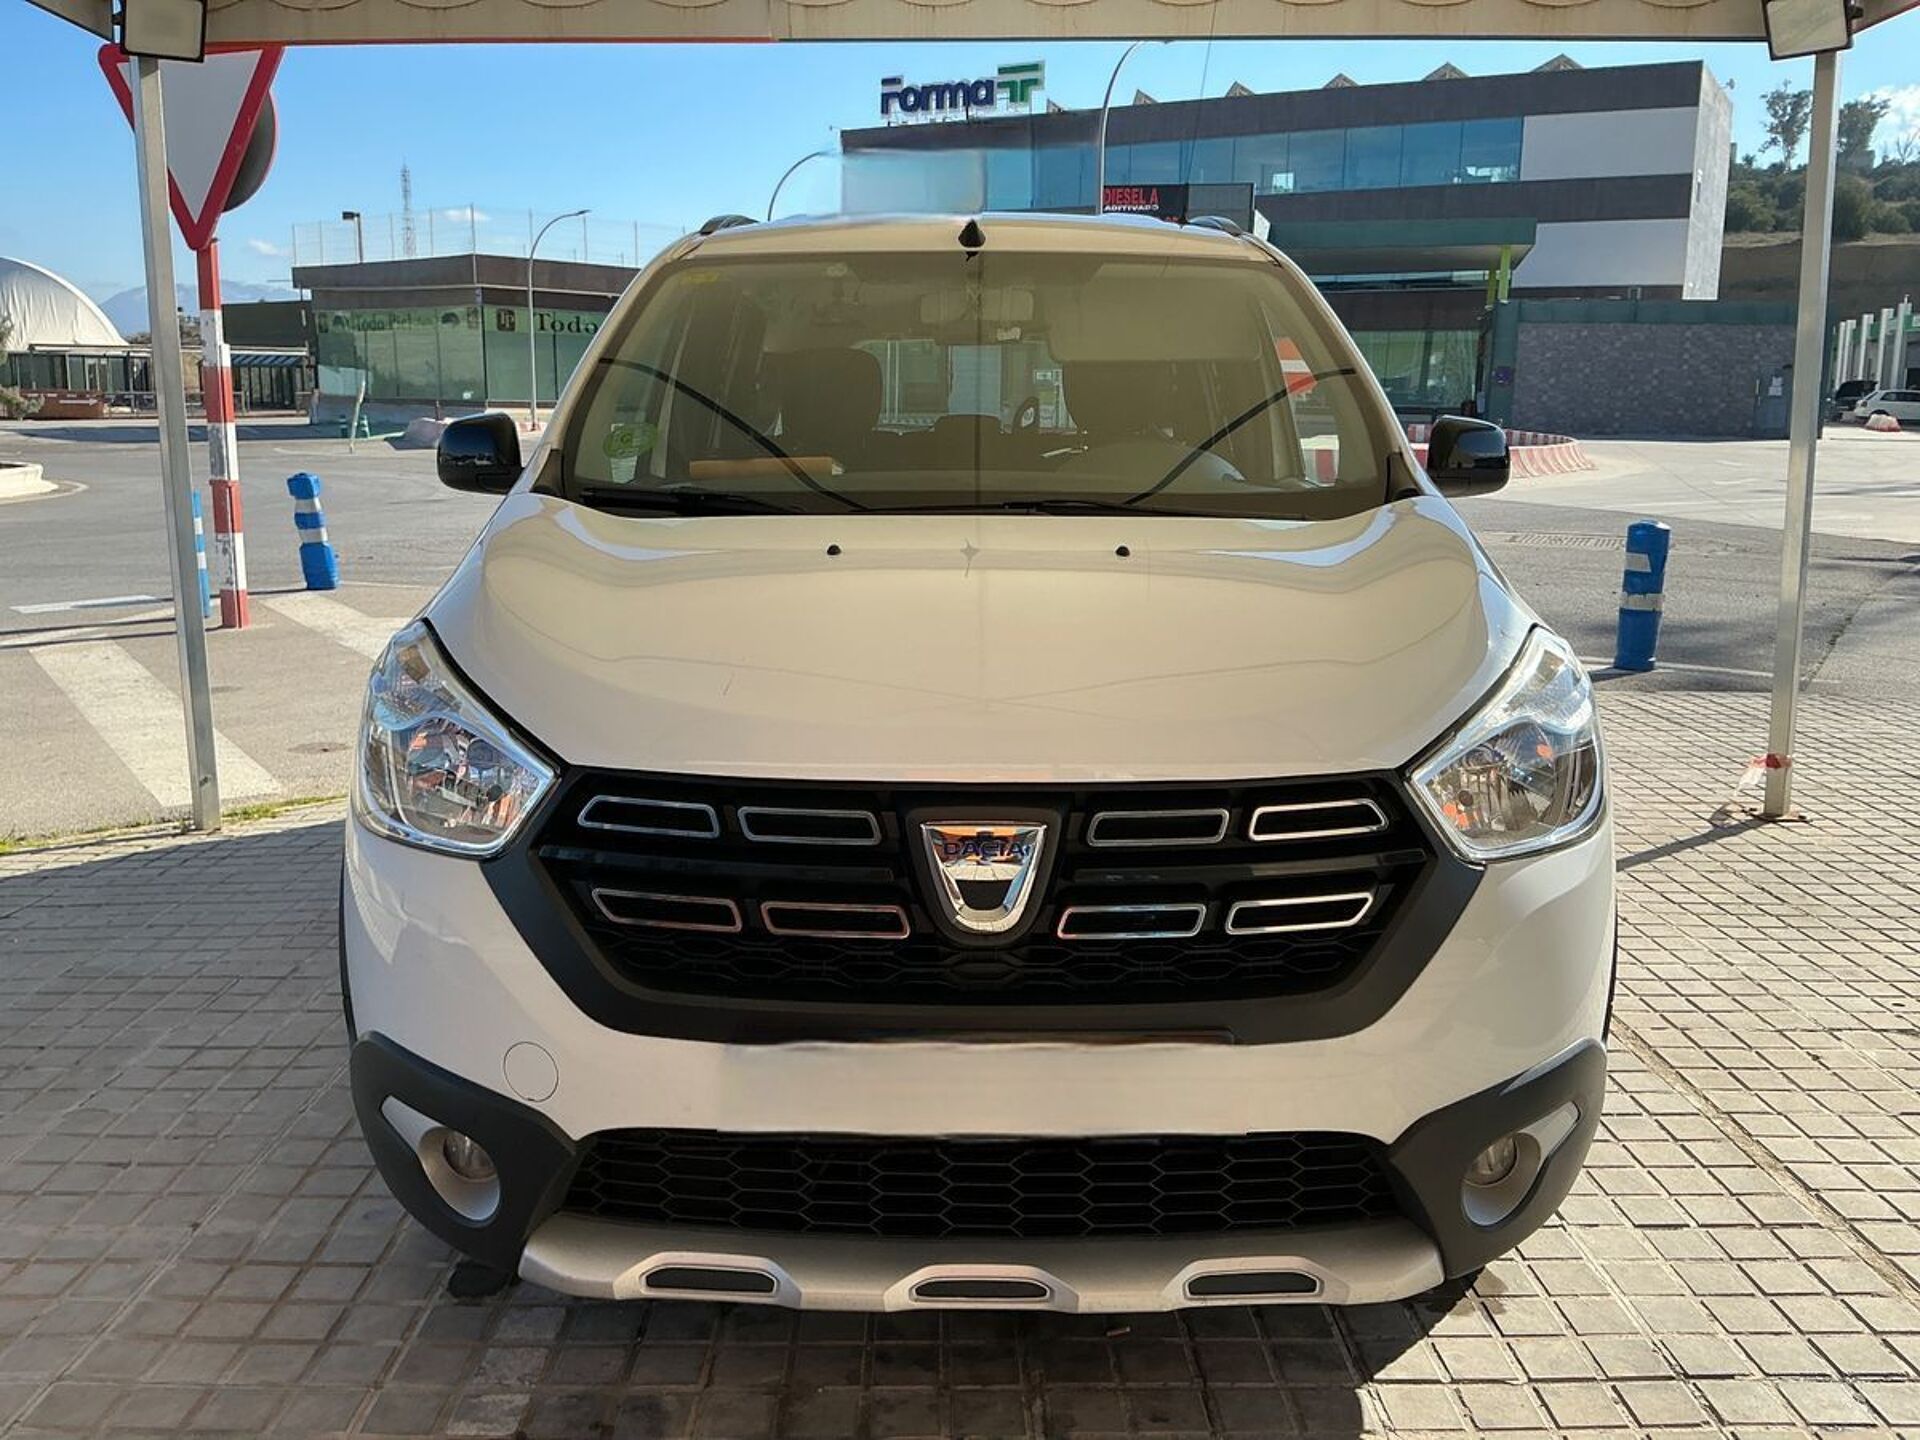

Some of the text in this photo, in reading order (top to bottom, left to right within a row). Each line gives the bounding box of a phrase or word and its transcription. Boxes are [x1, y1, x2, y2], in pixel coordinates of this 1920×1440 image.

[1104, 187, 1160, 205] DIESEL A
[1104, 204, 1160, 212] ADITIVADO
[534, 312, 600, 335] Todo
[943, 842, 1025, 856] DACIA
